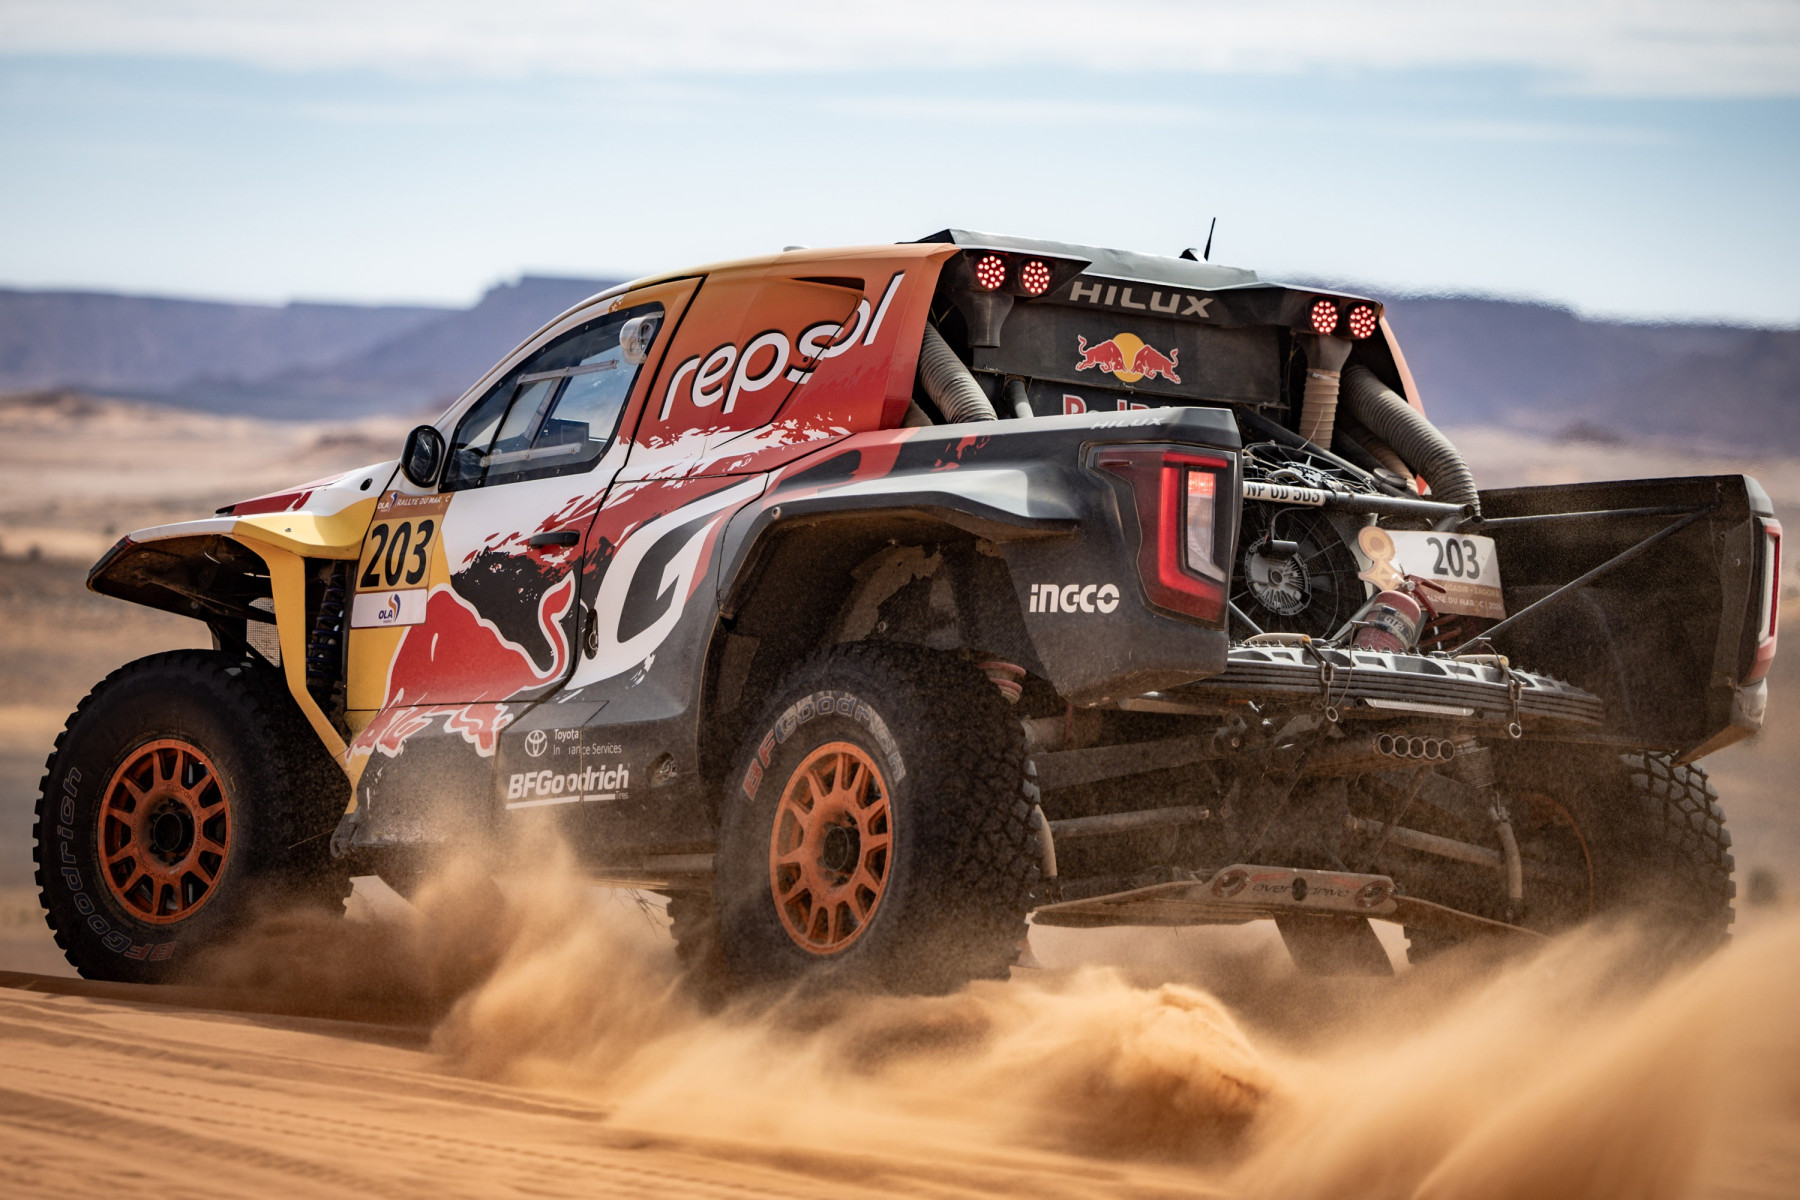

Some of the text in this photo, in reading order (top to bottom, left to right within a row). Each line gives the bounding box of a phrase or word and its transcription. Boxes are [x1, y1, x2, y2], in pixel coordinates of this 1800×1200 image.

[1069, 281, 1214, 318] HILUX
[658, 271, 905, 422] repsol
[1090, 417, 1166, 429] HILUX
[377, 502, 389, 510] OLA
[397, 497, 418, 507] RALLYE
[419, 497, 428, 505] DU
[360, 519, 434, 588] 203
[1426, 537, 1480, 580] 203
[378, 609, 393, 620] OLA
[554, 728, 579, 743] Toyota
[592, 742, 622, 755] Services
[507, 763, 630, 800] BFGoodrich
[616, 790, 629, 800] Tires
[57, 766, 177, 961] BFGoodrich
